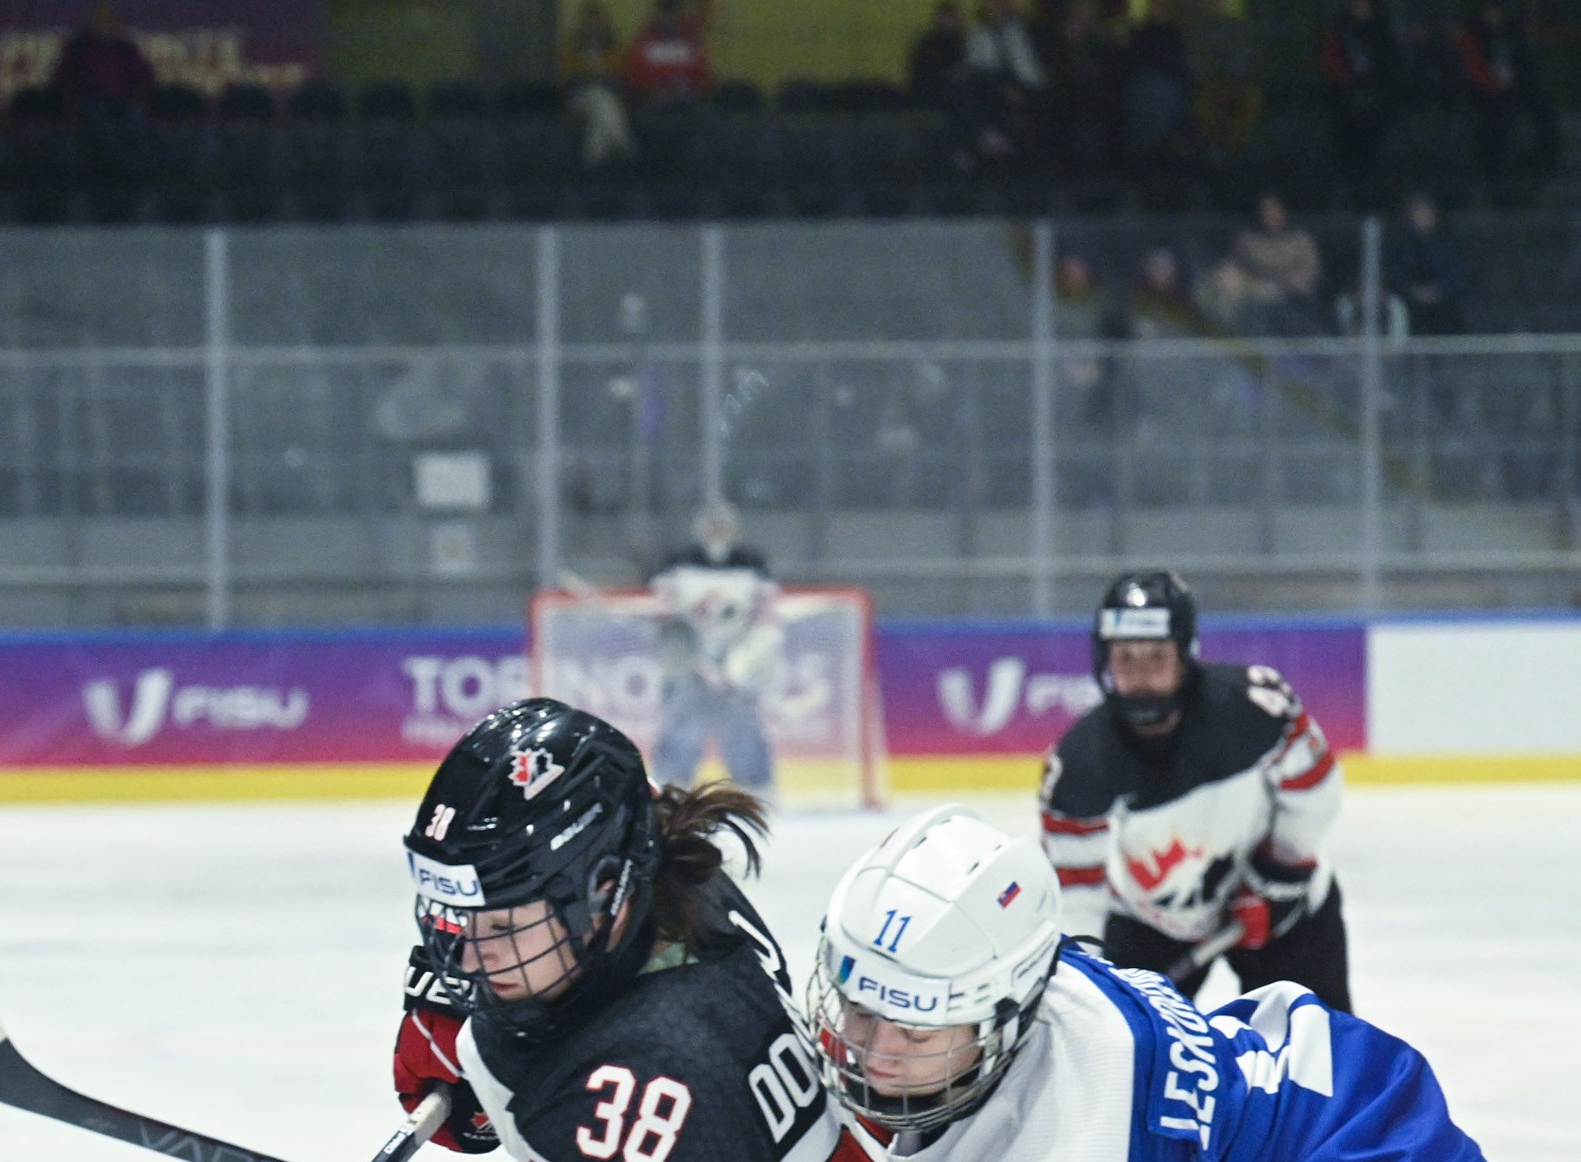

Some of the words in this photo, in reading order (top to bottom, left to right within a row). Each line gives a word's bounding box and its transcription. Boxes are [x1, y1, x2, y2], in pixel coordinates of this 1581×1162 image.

[419, 867, 480, 898] FISU
[873, 909, 912, 954] 11
[857, 977, 938, 1014] FISU
